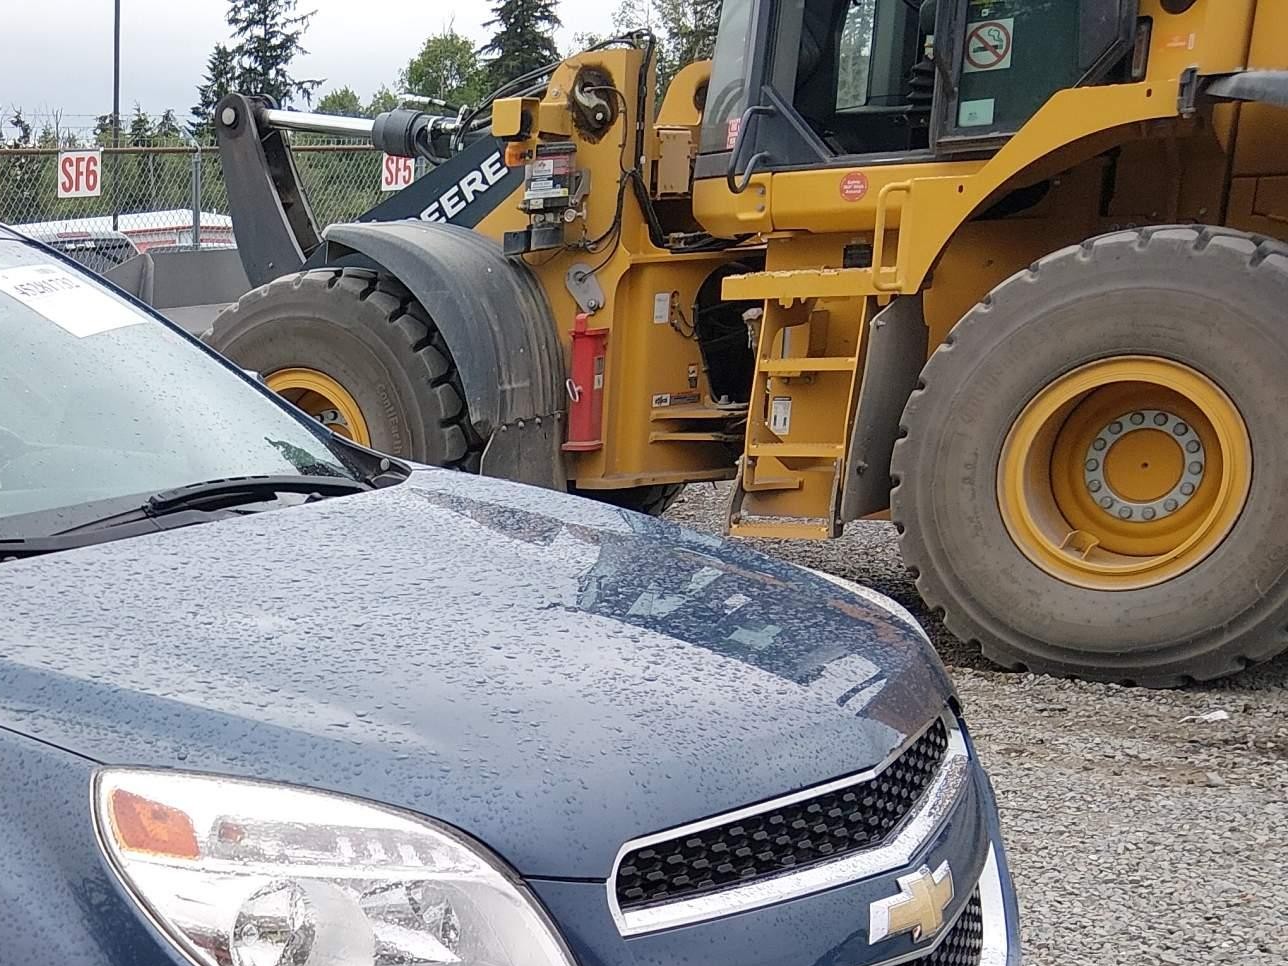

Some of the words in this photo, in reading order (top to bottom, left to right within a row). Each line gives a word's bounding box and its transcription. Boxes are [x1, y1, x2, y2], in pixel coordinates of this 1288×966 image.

[61, 156, 98, 193] SF6
[384, 154, 412, 186] SF5
[407, 151, 509, 223] EERE
